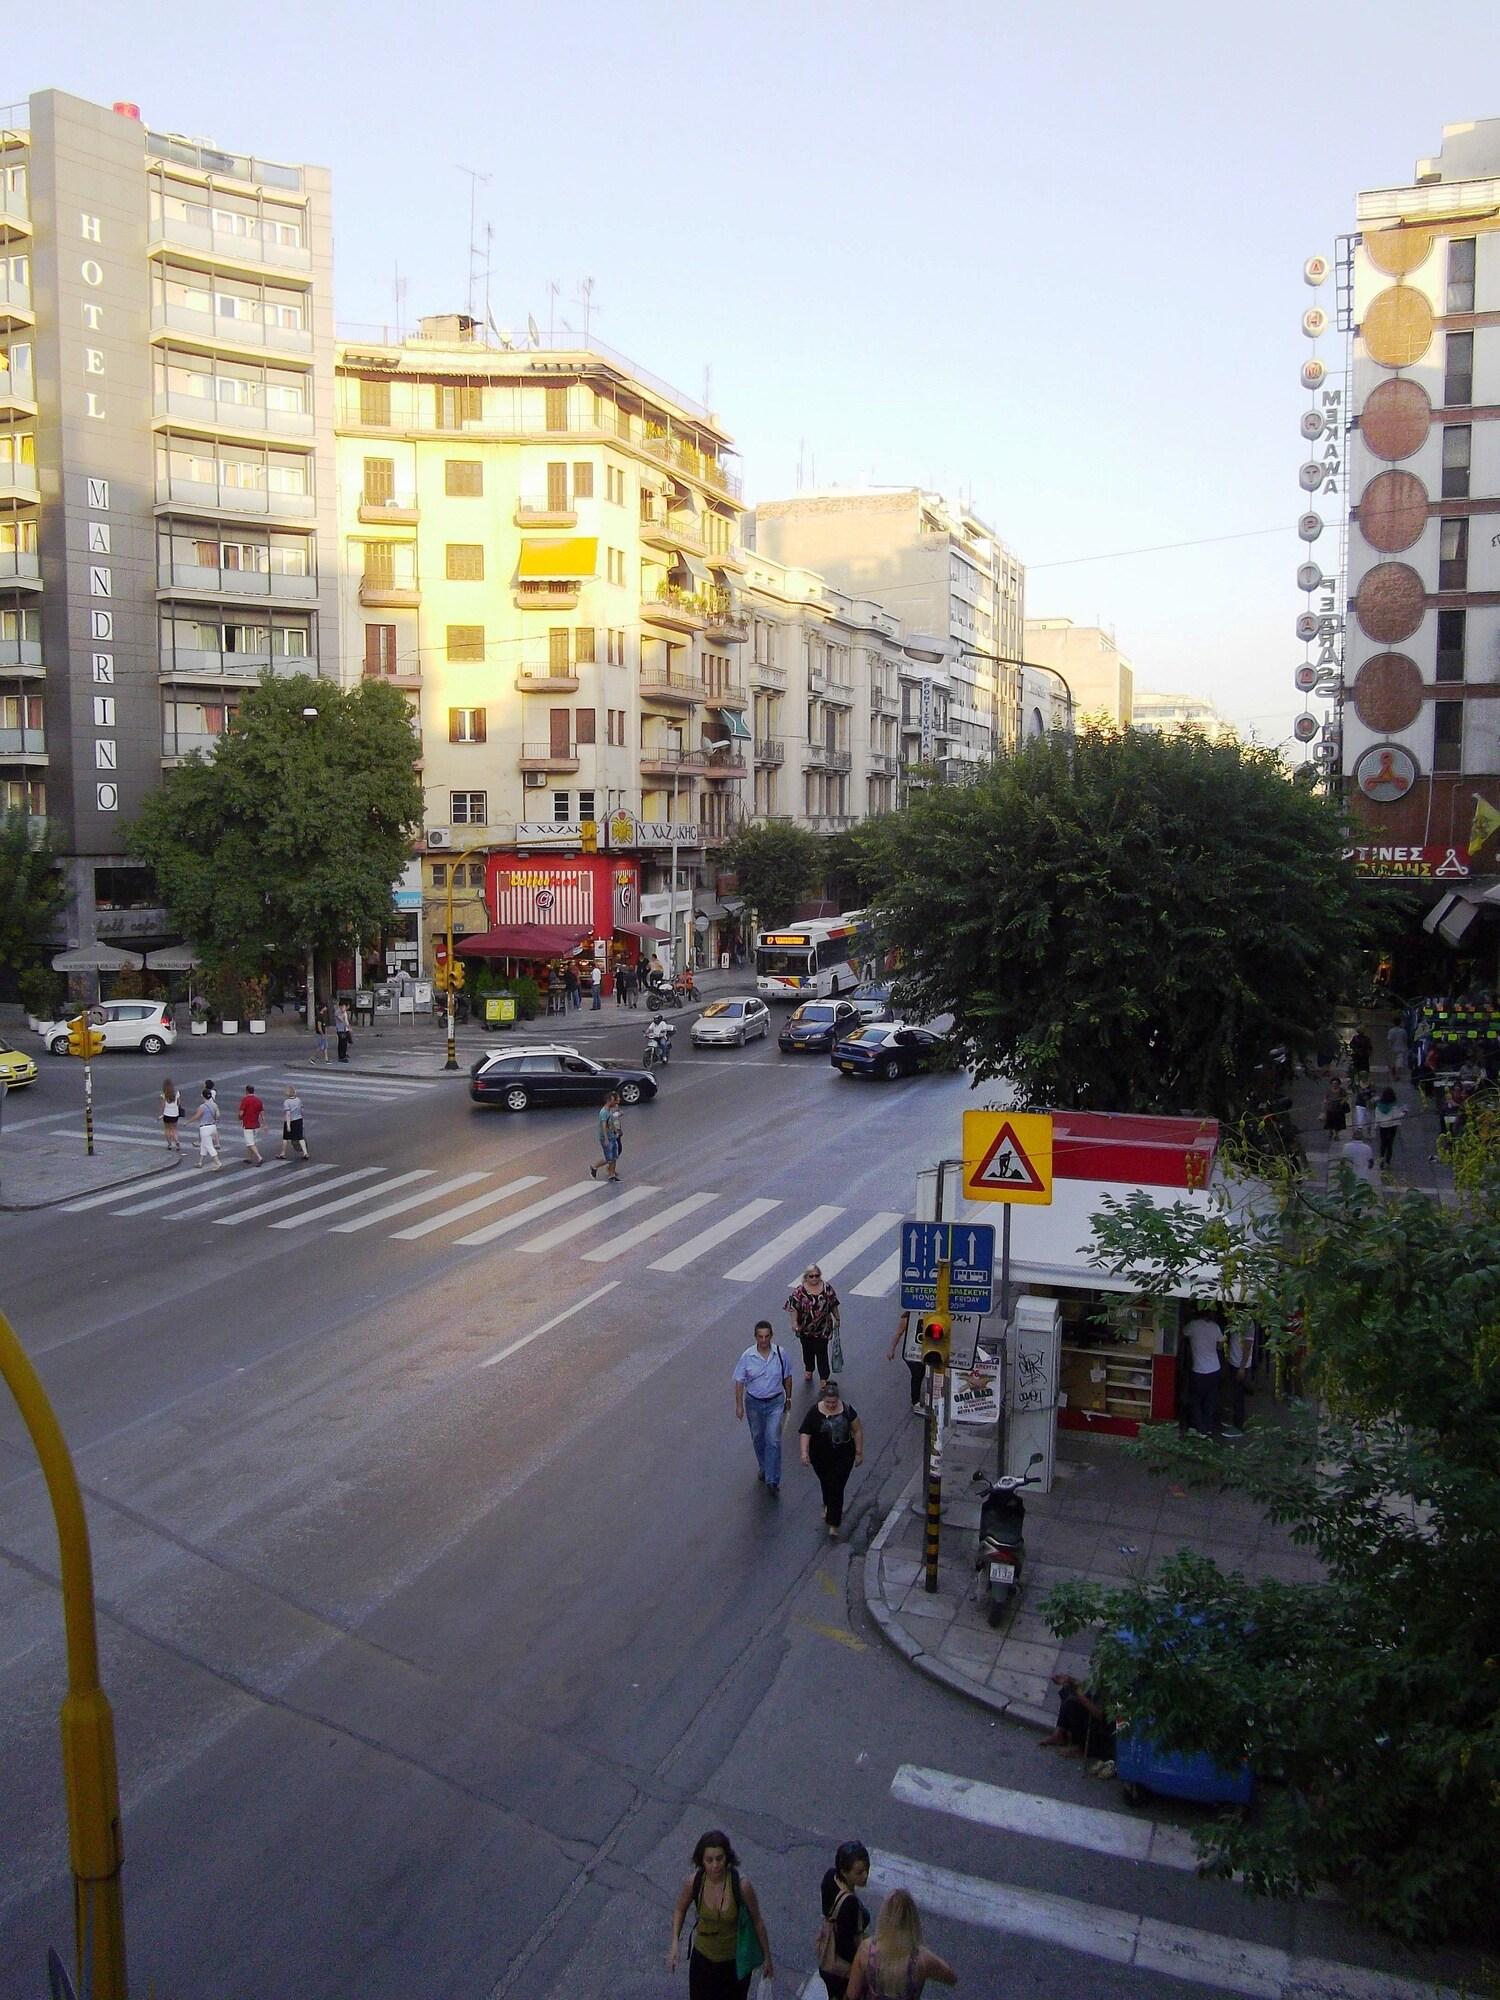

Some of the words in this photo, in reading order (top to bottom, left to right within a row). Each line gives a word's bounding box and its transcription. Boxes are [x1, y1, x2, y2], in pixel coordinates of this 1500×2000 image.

[80, 214, 105, 419] HOTEL
[88, 479, 118, 811] MANDRINO
[949, 1288, 988, 1297] ΑΡΑΣΚΕΥΗ
[954, 1295, 980, 1303] FRIDAY
